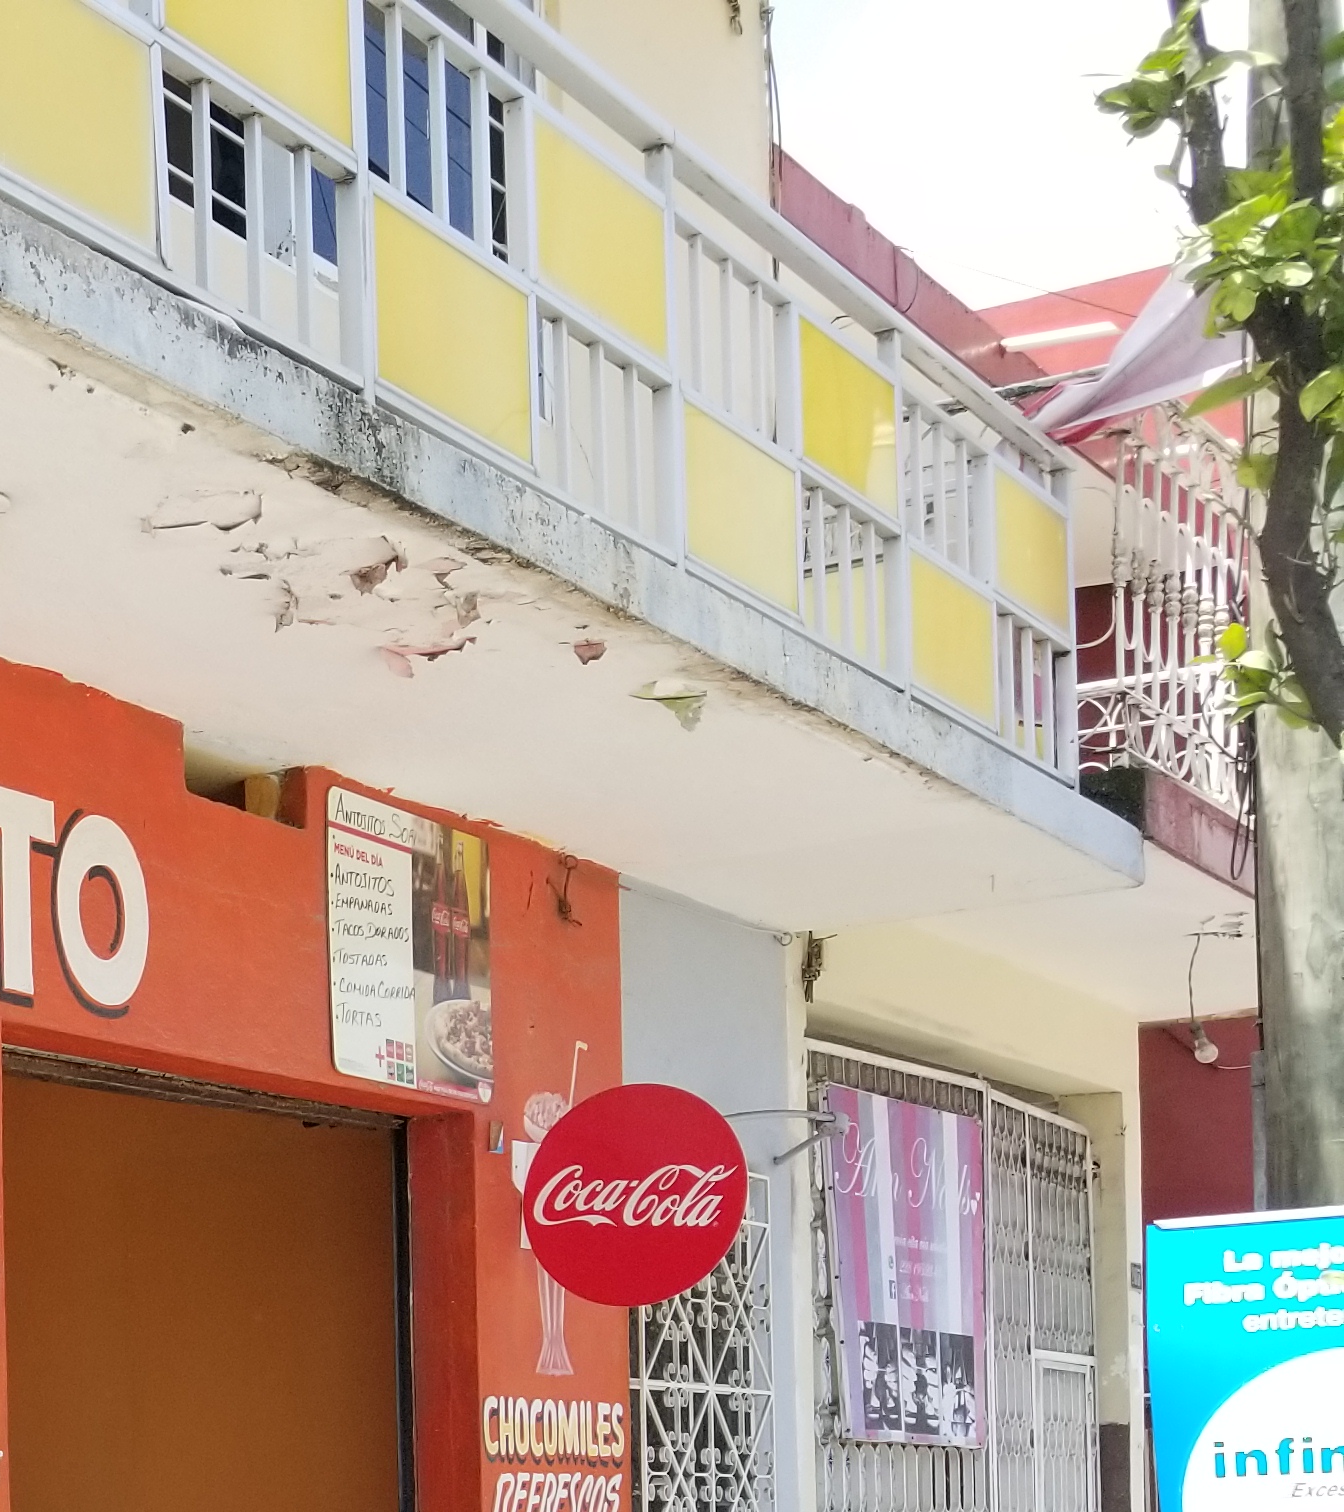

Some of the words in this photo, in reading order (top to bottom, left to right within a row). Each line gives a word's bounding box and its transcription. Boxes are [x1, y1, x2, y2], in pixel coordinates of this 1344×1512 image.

[335, 863, 395, 897] ANTOJITOS
[533, 1164, 739, 1228] Coca-Cola
[483, 1396, 625, 1464] CHOCOMILES
